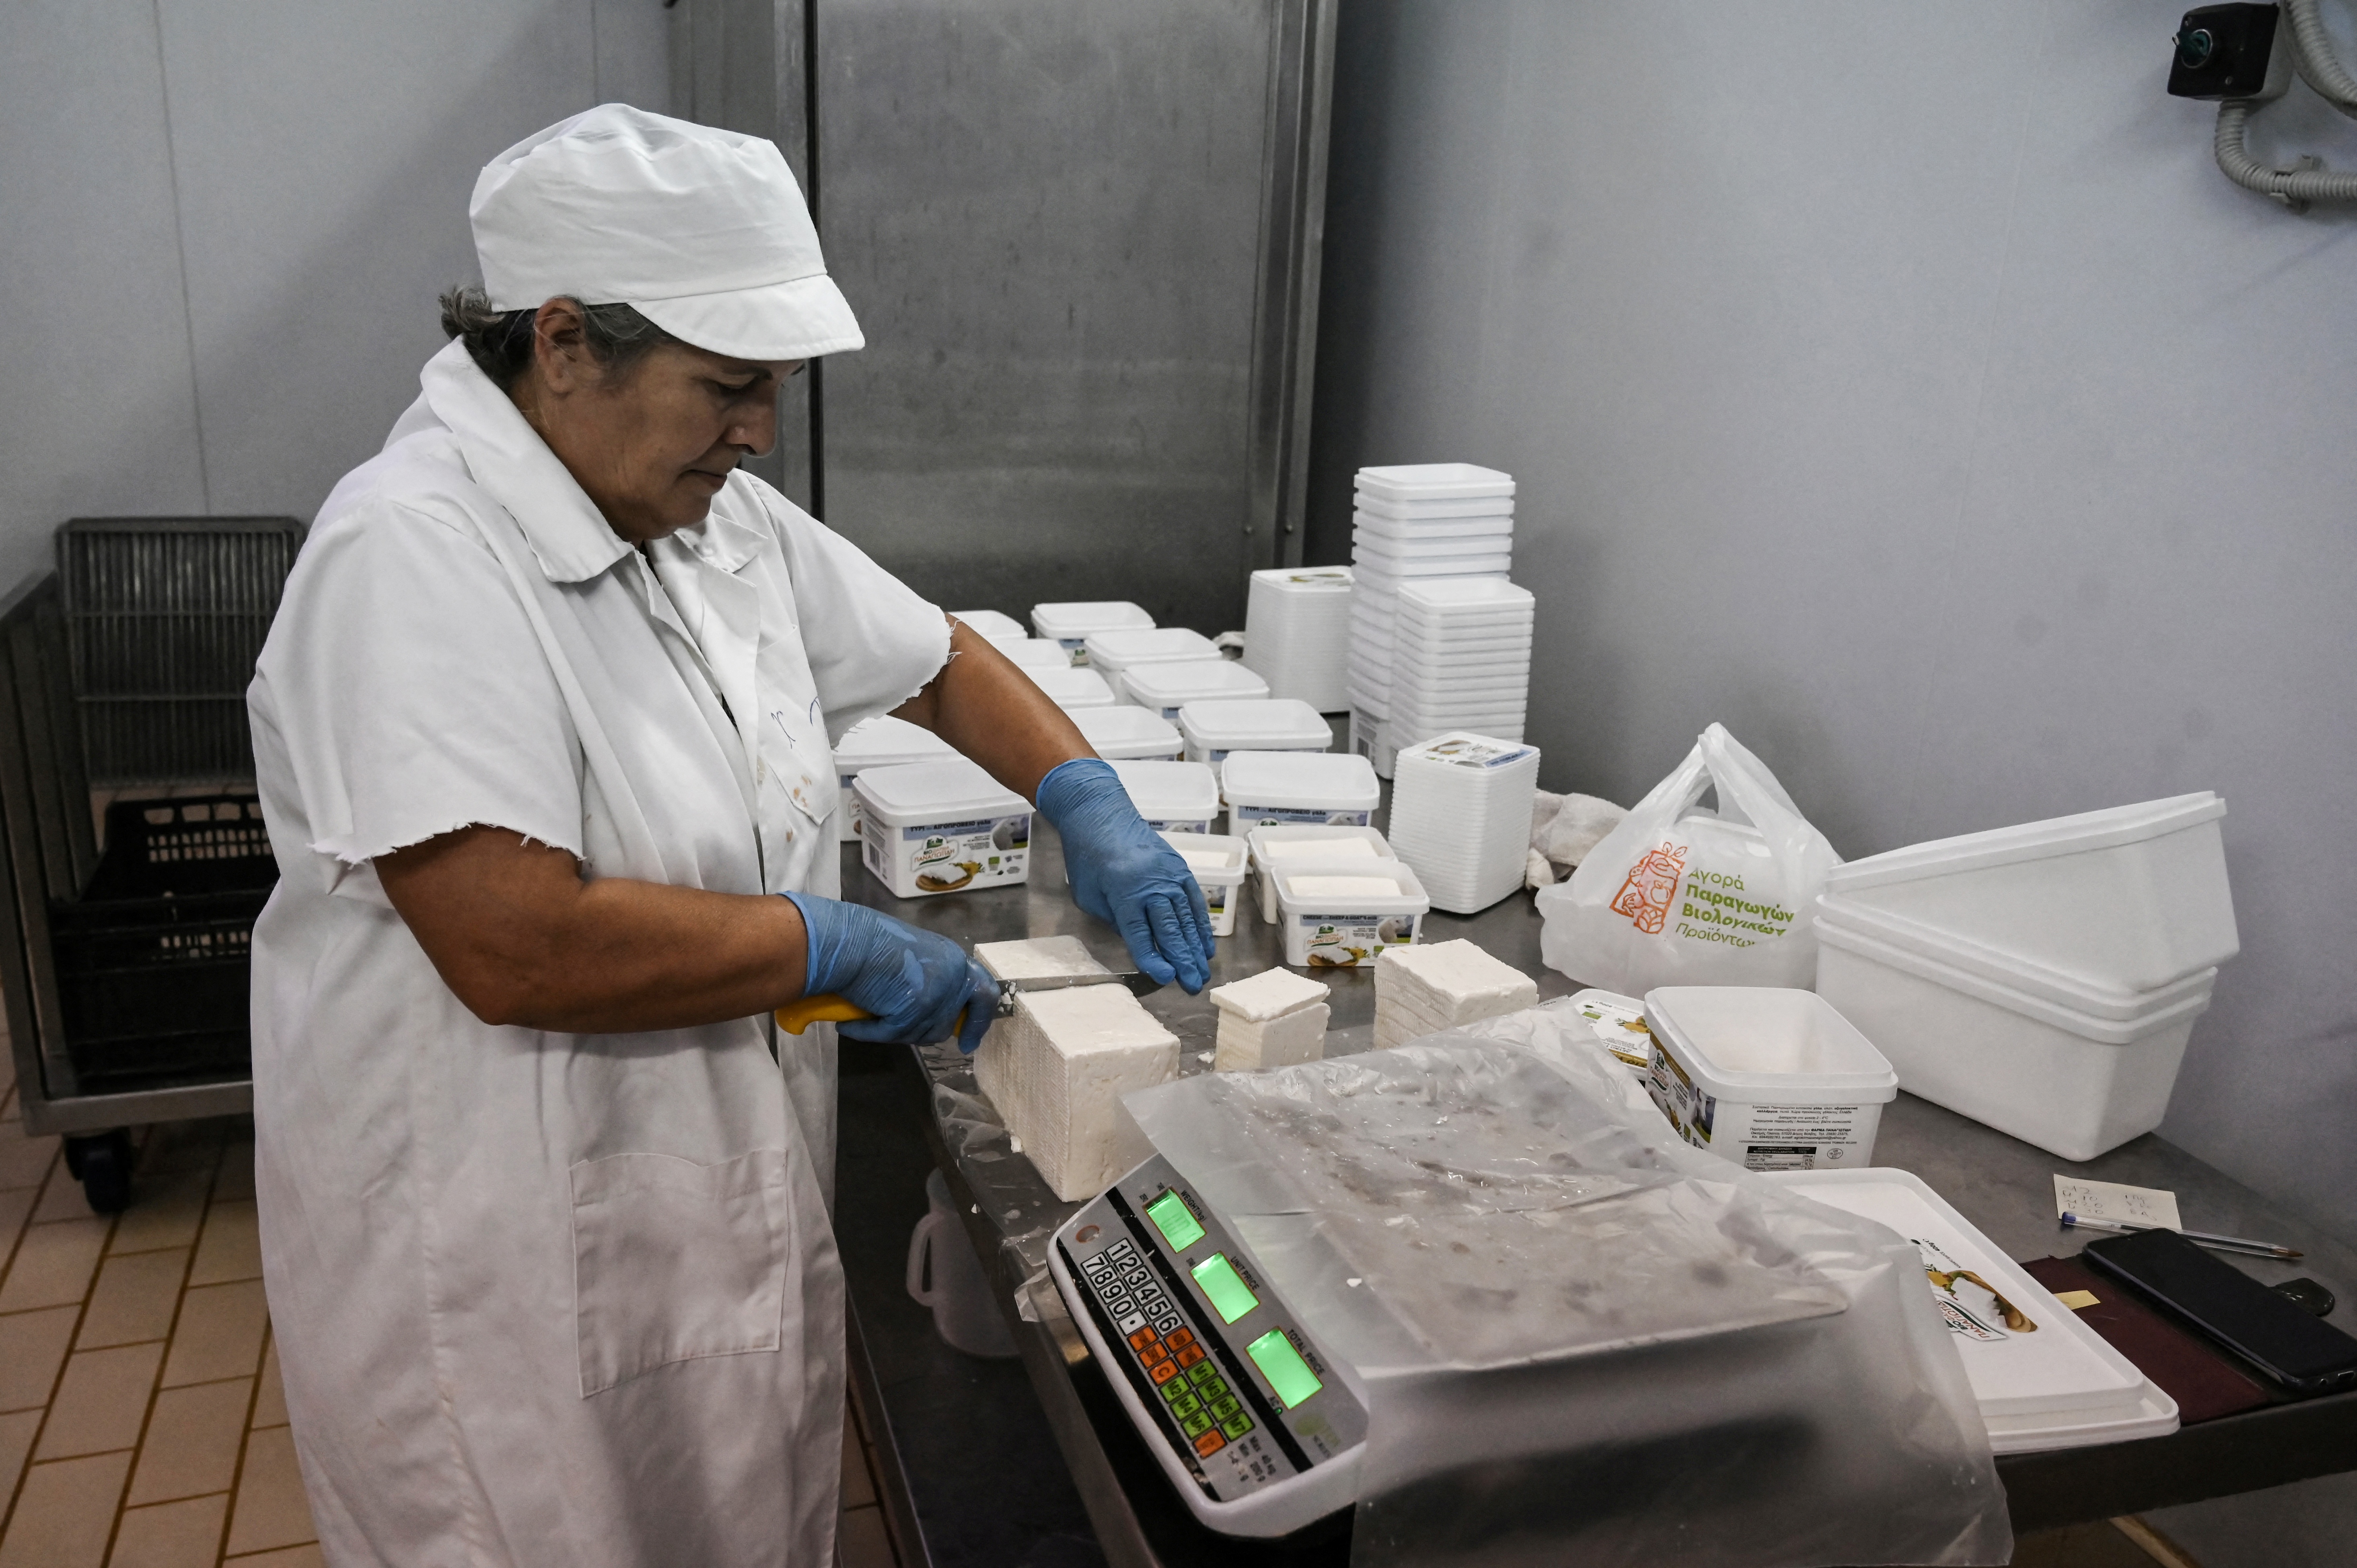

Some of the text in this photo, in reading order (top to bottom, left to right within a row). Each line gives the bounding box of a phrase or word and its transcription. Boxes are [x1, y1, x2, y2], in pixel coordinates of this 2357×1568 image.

[1688, 867, 1744, 891] Αγορά
[1686, 884, 1795, 923] Παραγωγών
[1682, 903, 1786, 937] Βιολογικών
[1181, 1190, 1207, 1222] WEIGHT(kg)
[1111, 1244, 1128, 1256] 1
[1928, 1242, 1940, 1252] 400g
[1086, 1256, 1105, 1268] 7
[1118, 1257, 1137, 1272] 2
[1094, 1271, 1113, 1285] 8
[1128, 1271, 1147, 1285] 3
[1231, 1256, 1260, 1291] UNIT PRICE
[1103, 1284, 1122, 1299] 9
[1140, 1289, 1158, 1301] 4
[1113, 1300, 1132, 1315] 0
[1148, 1300, 1168, 1315] 5
[1159, 1316, 1178, 1331] 6
[1287, 1328, 1325, 1375] TOTAL PRICE
[1158, 1367, 1169, 1377] C
[1195, 1365, 1209, 1380] M1
[1166, 1380, 1182, 1397] M2
[1204, 1380, 1221, 1397] M3
[1178, 1397, 1193, 1414] M4
[1217, 1398, 1233, 1415] M5
[1268, 1396, 1279, 1407] AC
[1189, 1415, 1205, 1431] M6
[1228, 1416, 1245, 1432] M7
